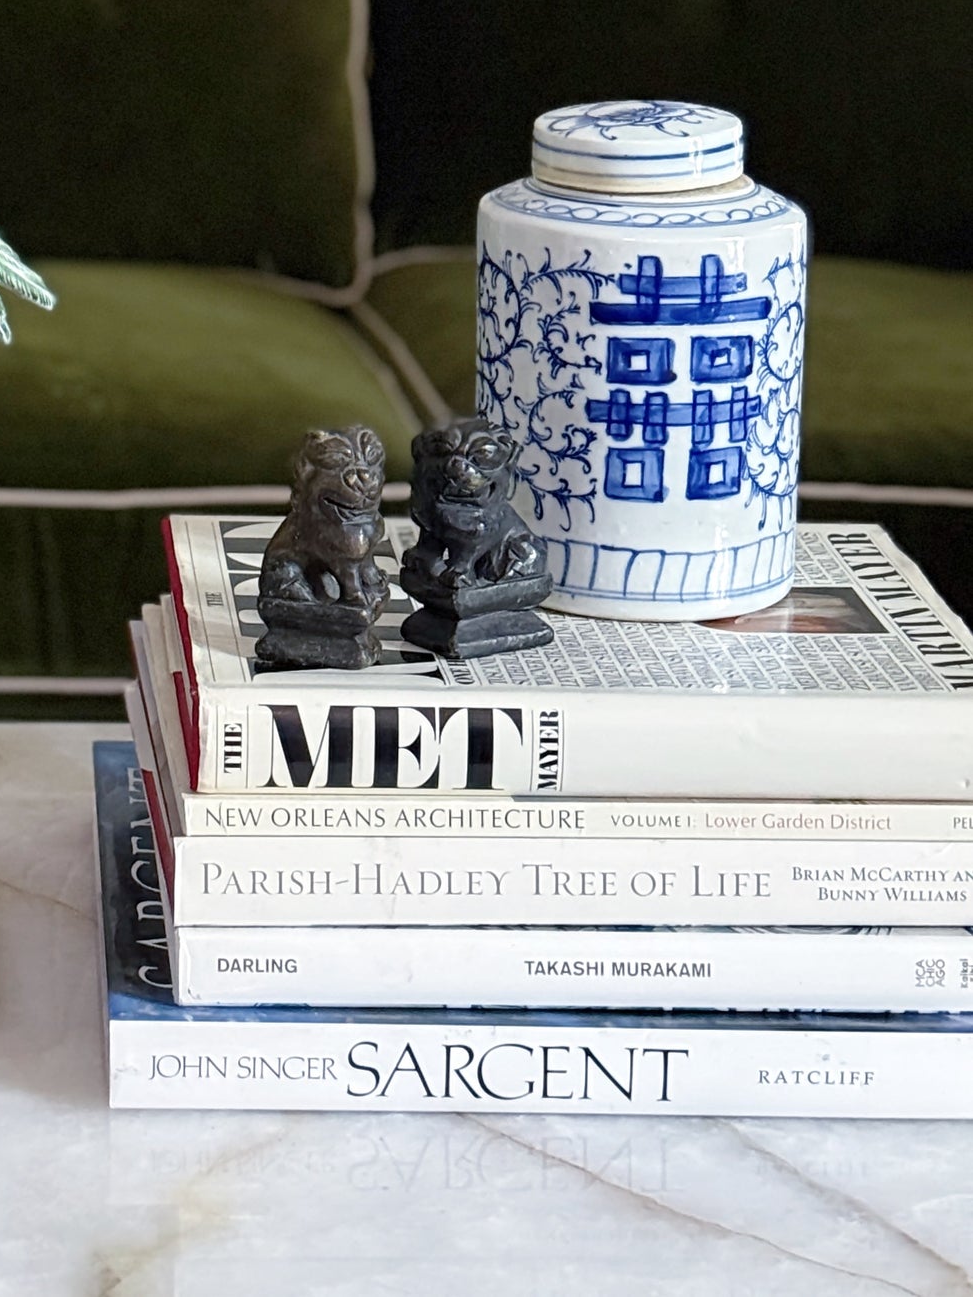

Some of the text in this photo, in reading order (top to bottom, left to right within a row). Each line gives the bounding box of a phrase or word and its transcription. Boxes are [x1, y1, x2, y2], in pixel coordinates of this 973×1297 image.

[204, 591, 224, 606] THE
[826, 531, 973, 691] MARTIN MAYER
[223, 722, 243, 774] THE
[256, 704, 524, 790] MET
[537, 708, 561, 792] MAYER
[205, 807, 263, 828] NEW
[270, 807, 386, 829] ORLEANS
[394, 808, 586, 830] ARCHITECTURE
[610, 814, 682, 829] VOLUME
[705, 813, 756, 830] Lower
[762, 813, 825, 831] Garden
[830, 813, 892, 831] District
[201, 862, 772, 898] PARISH-HADLEY TREE OF LIFE
[791, 866, 845, 883] BRIAN
[817, 886, 968, 903] BUNNY WILLIAMS
[216, 957, 299, 974] DARLING
[524, 960, 712, 979] TAKASHI MURAKAMI
[915, 958, 925, 988] MCA
[935, 958, 946, 988] AGO
[148, 1040, 690, 1103] JOHN SINGER SARGENT
[758, 1069, 876, 1087] RATCLIFF
